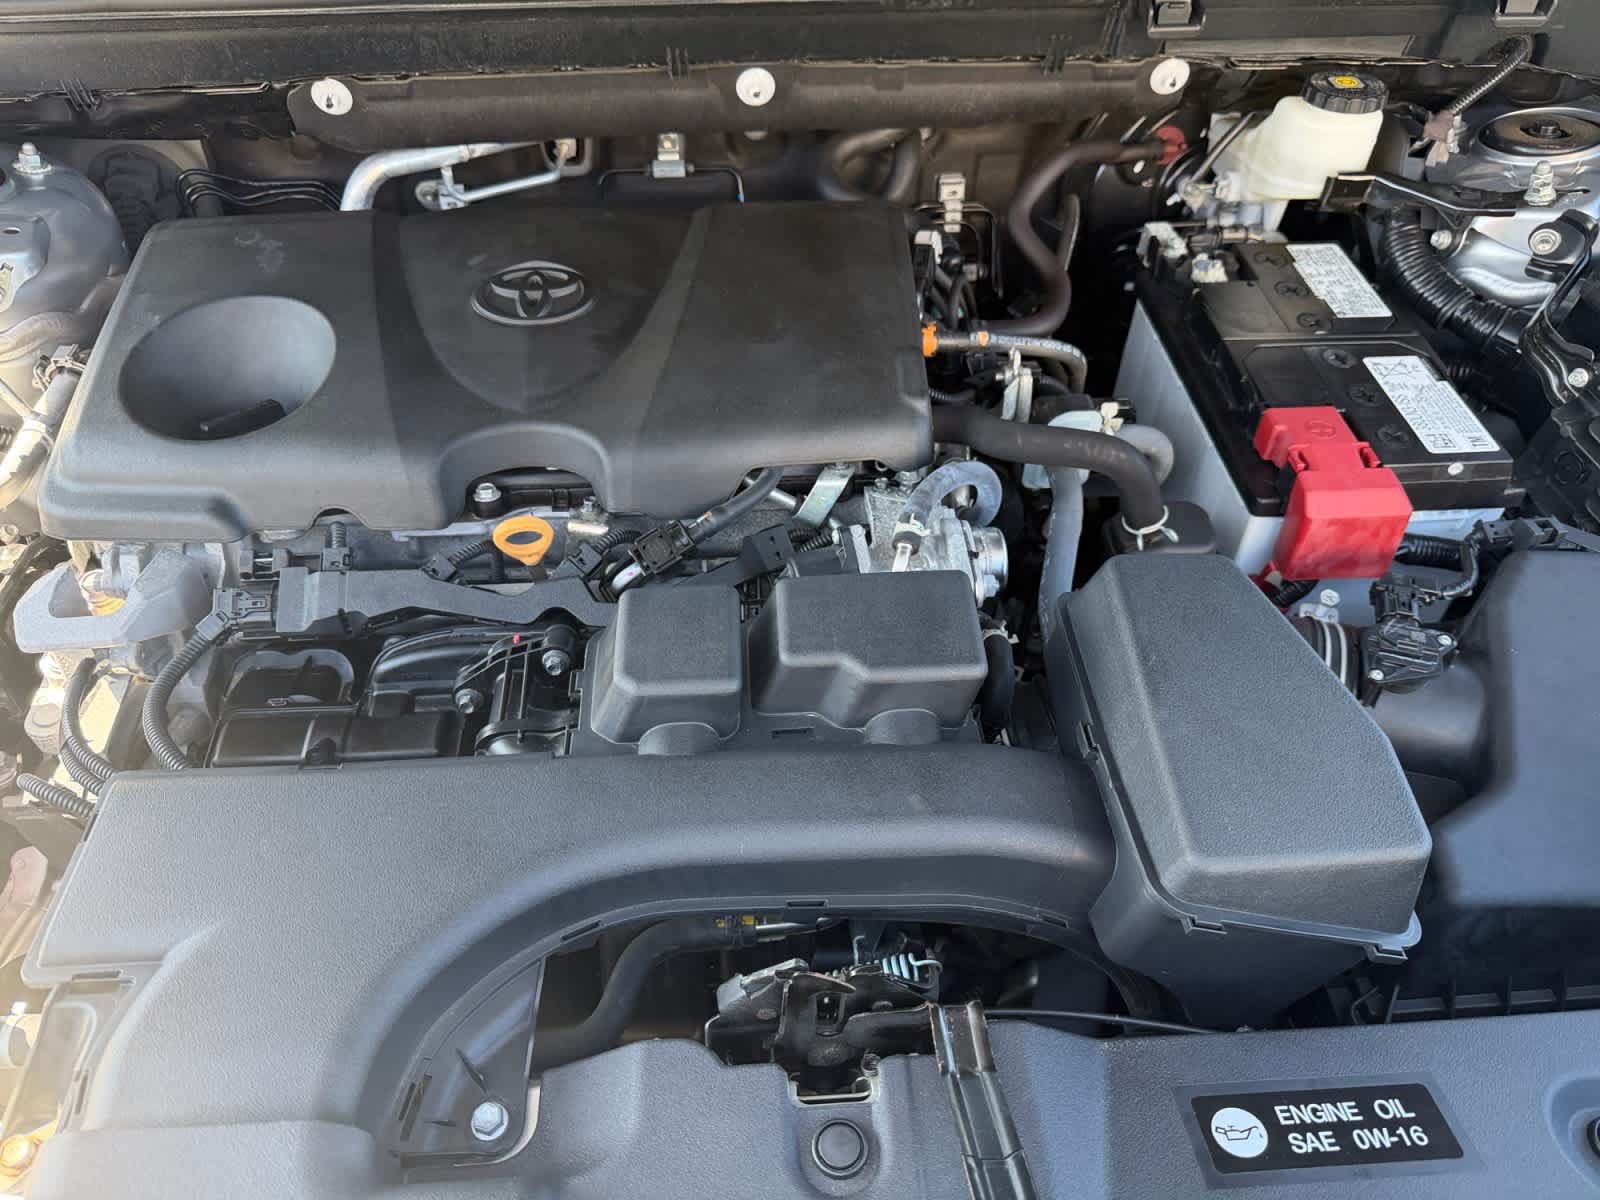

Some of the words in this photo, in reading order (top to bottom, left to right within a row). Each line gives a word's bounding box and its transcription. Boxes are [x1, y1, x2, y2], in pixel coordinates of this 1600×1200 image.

[1274, 1102, 1363, 1125] ENGINE
[1374, 1099, 1416, 1119] OIL
[1288, 1131, 1340, 1153] SAE
[1353, 1126, 1428, 1149] 0W-16
